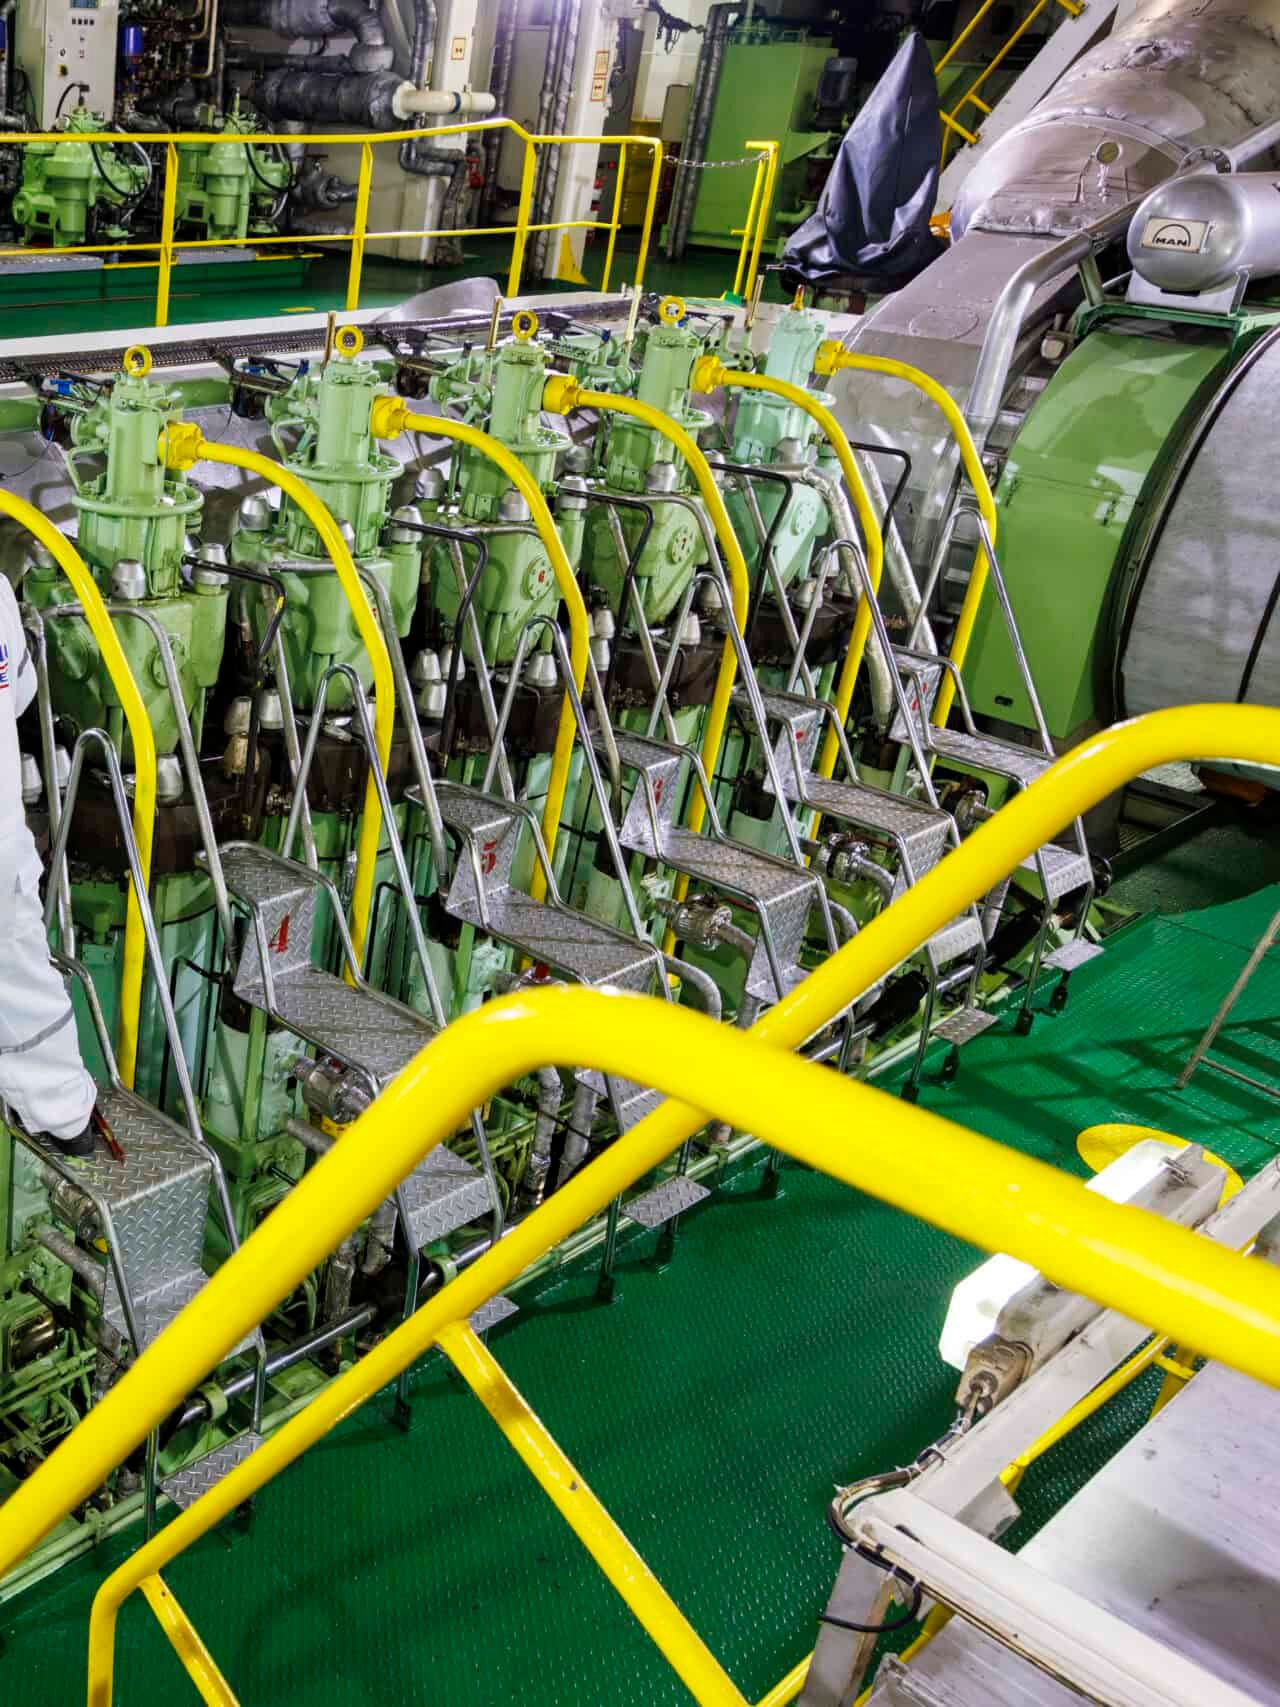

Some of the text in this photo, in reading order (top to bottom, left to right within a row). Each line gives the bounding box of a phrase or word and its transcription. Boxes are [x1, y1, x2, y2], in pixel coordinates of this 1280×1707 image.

[1155, 237, 1187, 247] MAN
[480, 838, 497, 876] 5
[267, 913, 290, 954] 4
